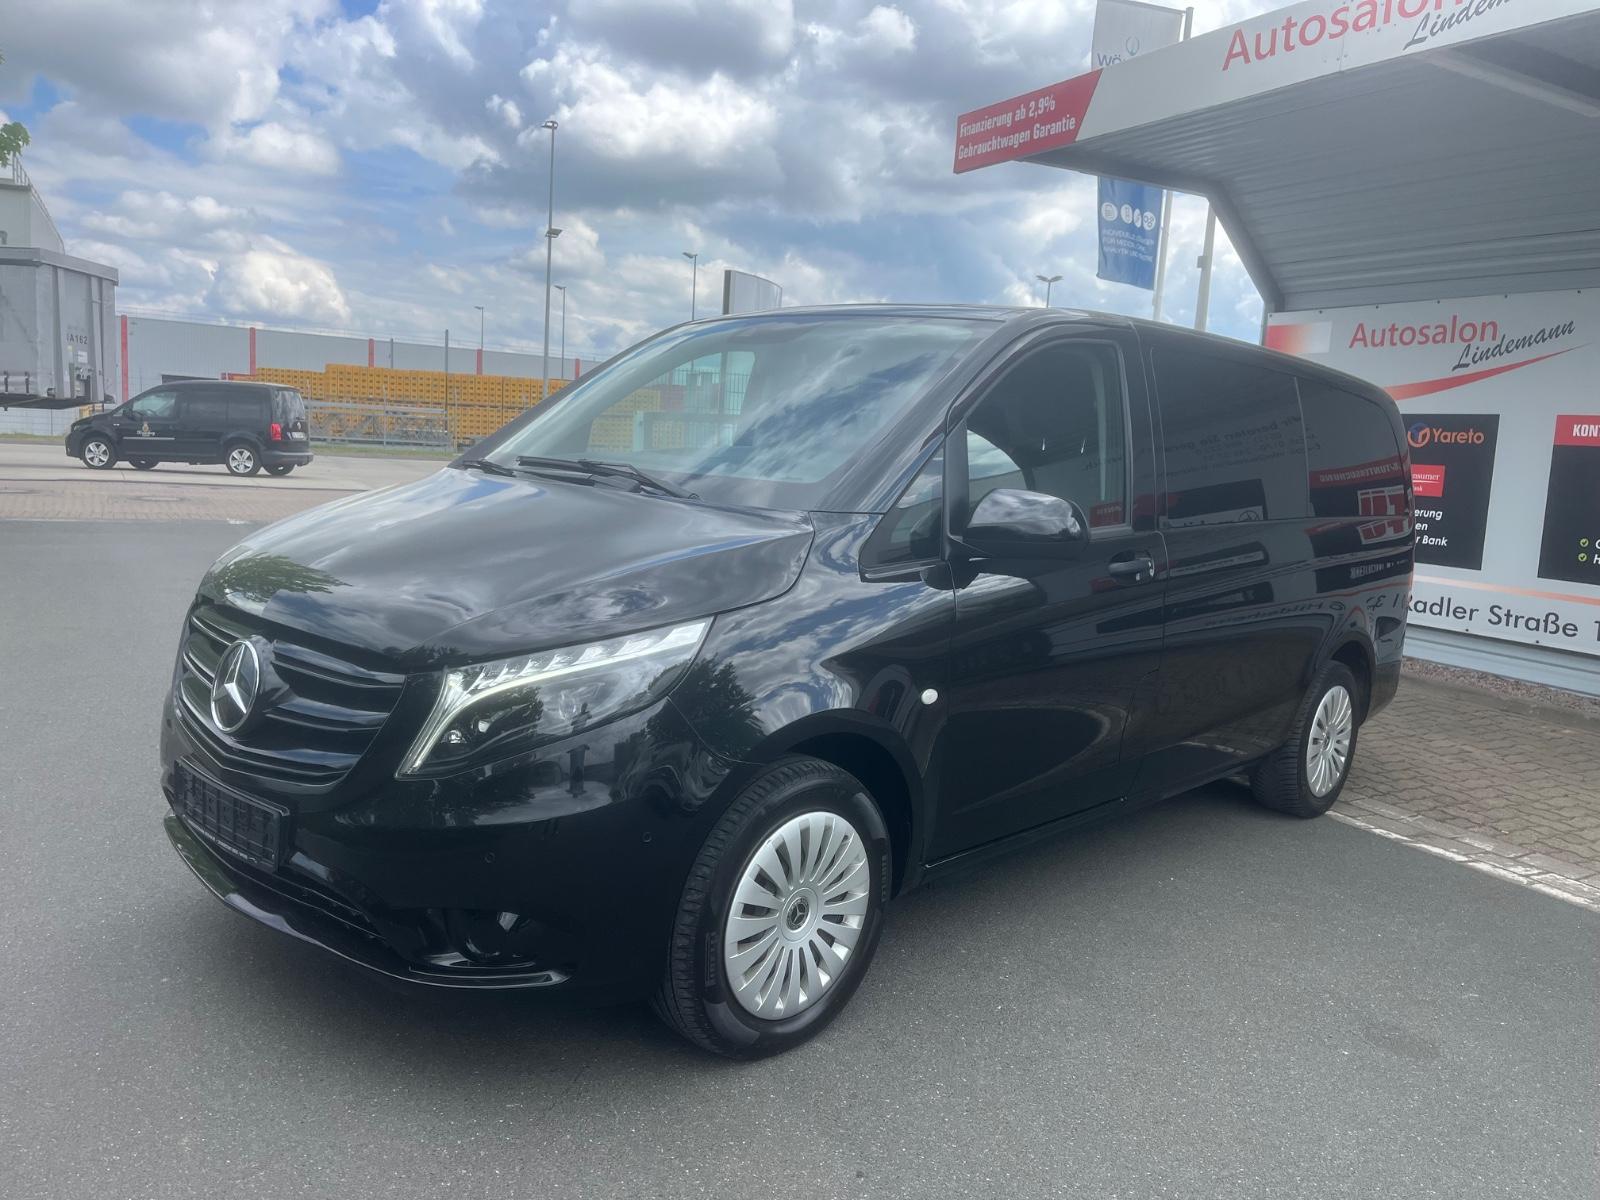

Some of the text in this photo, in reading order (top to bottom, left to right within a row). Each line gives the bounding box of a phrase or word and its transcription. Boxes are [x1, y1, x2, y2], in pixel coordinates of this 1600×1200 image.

[1222, 0, 1464, 71] Autosalo
[959, 94, 1056, 138] Finanzierung ab 2,9%
[958, 114, 1076, 160] Gebrauchtwagen Garantie
[1349, 315, 1498, 349] Autosalon
[1452, 320, 1575, 371] Lindemann
[1432, 428, 1484, 444] Yareto
[1573, 424, 1600, 437] KON
[1422, 535, 1448, 546] Bank
[1488, 605, 1578, 637] Straße
